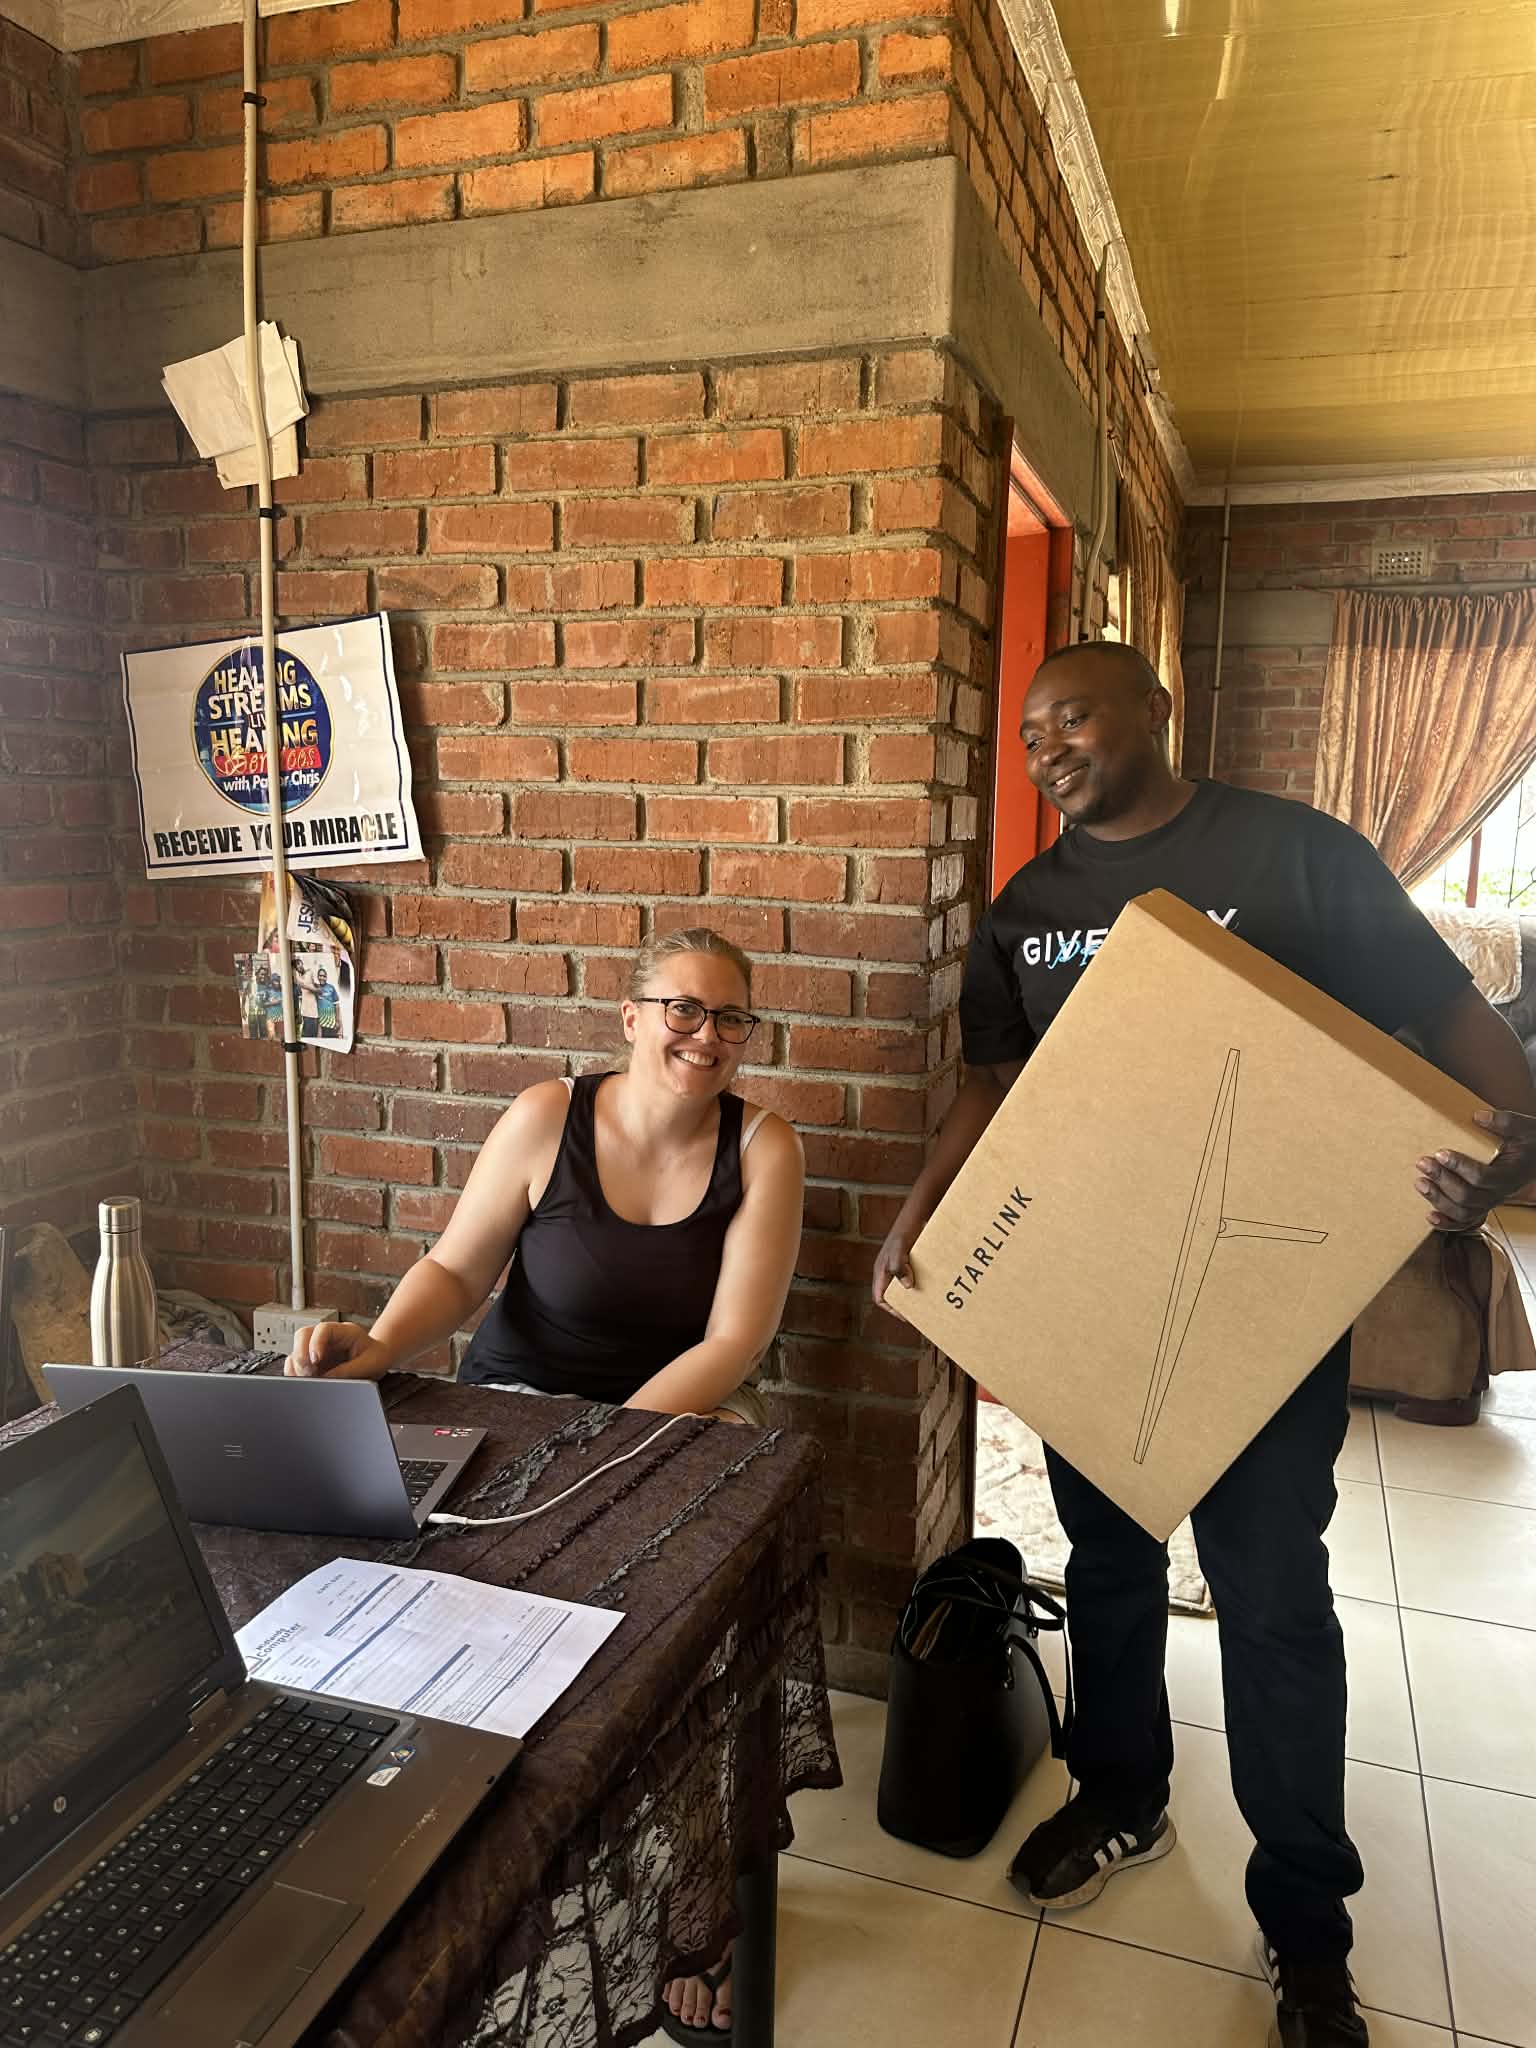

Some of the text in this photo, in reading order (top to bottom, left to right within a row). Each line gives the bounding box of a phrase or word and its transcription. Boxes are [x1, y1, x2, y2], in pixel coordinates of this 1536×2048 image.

[214, 660, 296, 693] HEALNG
[208, 684, 312, 719] STREMS
[210, 719, 318, 757] HEANG
[224, 769, 320, 792] with Paor Chris
[153, 826, 243, 858] RECEIVE
[310, 812, 398, 847] MIRACLE
[946, 1185, 1033, 1310] STARLINK
